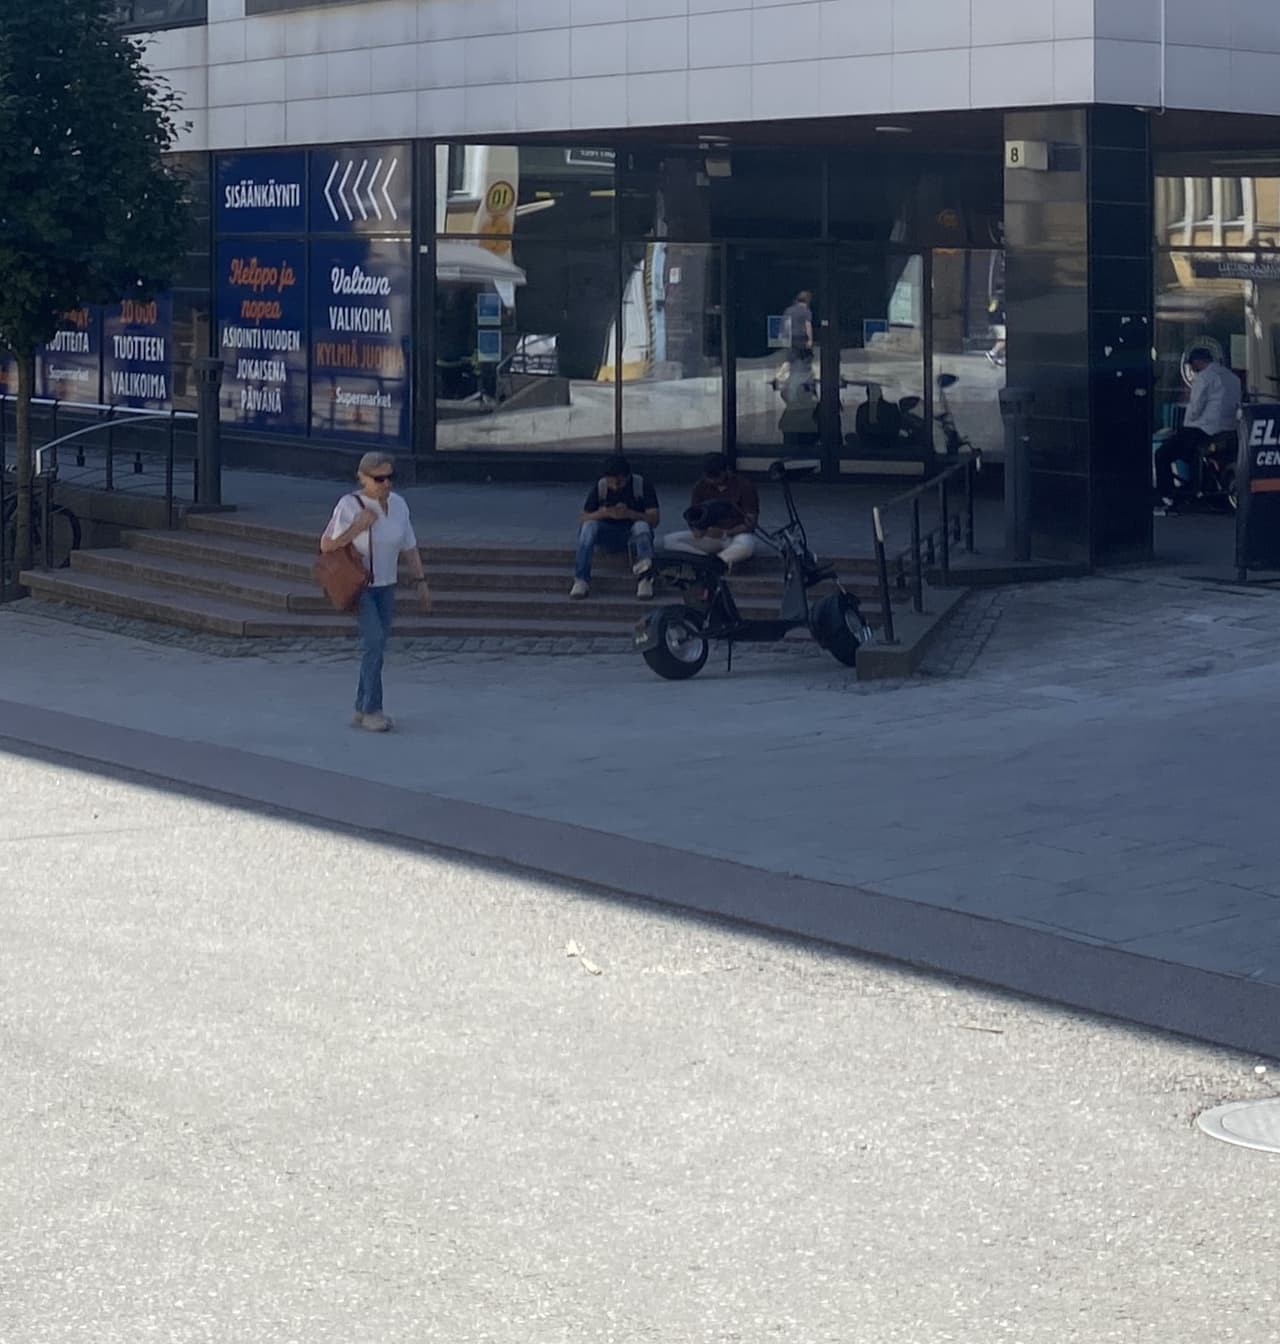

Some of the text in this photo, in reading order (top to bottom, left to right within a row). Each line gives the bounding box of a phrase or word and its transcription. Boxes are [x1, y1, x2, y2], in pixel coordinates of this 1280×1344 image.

[1010, 146, 1020, 163] 8
[224, 179, 300, 209] SISÄÄNKÄYNTI
[229, 257, 296, 292] Helppo ja
[331, 266, 392, 296] Valtava
[240, 299, 282, 325] nopea
[329, 307, 392, 333] VALIKOIMA
[113, 335, 165, 361] TUOTTEEN
[222, 327, 300, 352] ASIOINTI VUODEN
[236, 358, 286, 381] JOKAISENA
[111, 371, 166, 399] VALIKOIMA
[335, 386, 392, 409] Supermarket
[240, 385, 282, 413] PÄIVÄNÄ
